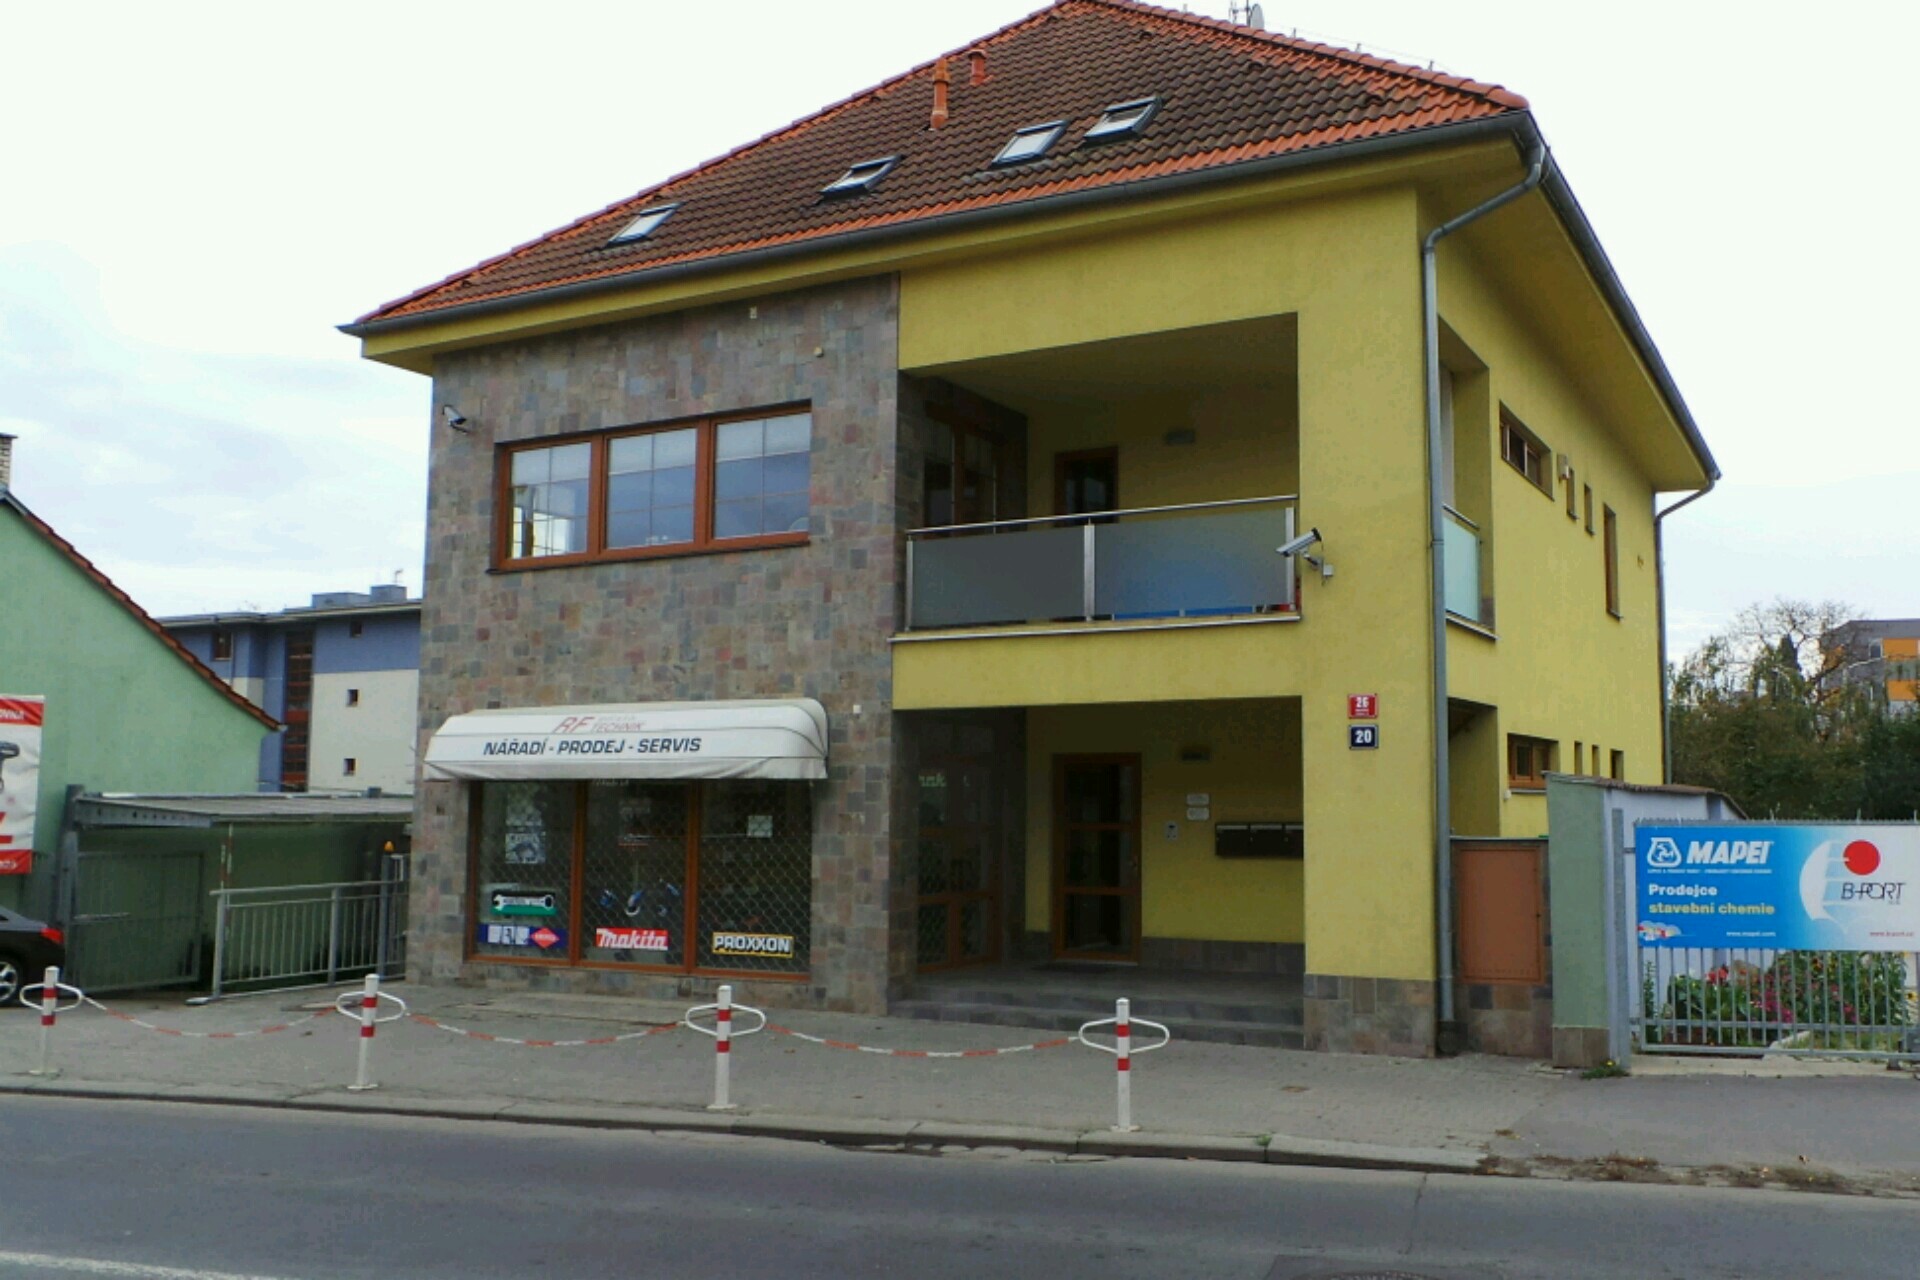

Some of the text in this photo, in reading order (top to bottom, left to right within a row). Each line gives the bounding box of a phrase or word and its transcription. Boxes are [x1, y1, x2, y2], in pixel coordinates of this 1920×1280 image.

[1355, 729, 1372, 743] 20
[557, 739, 626, 755] PRODEJ
[637, 738, 702, 754] SERVIS
[1686, 841, 1771, 864] MAPEI
[1648, 883, 1717, 898] Prodejce
[1718, 902, 1775, 914] chemie
[714, 935, 791, 953] PROXXON
